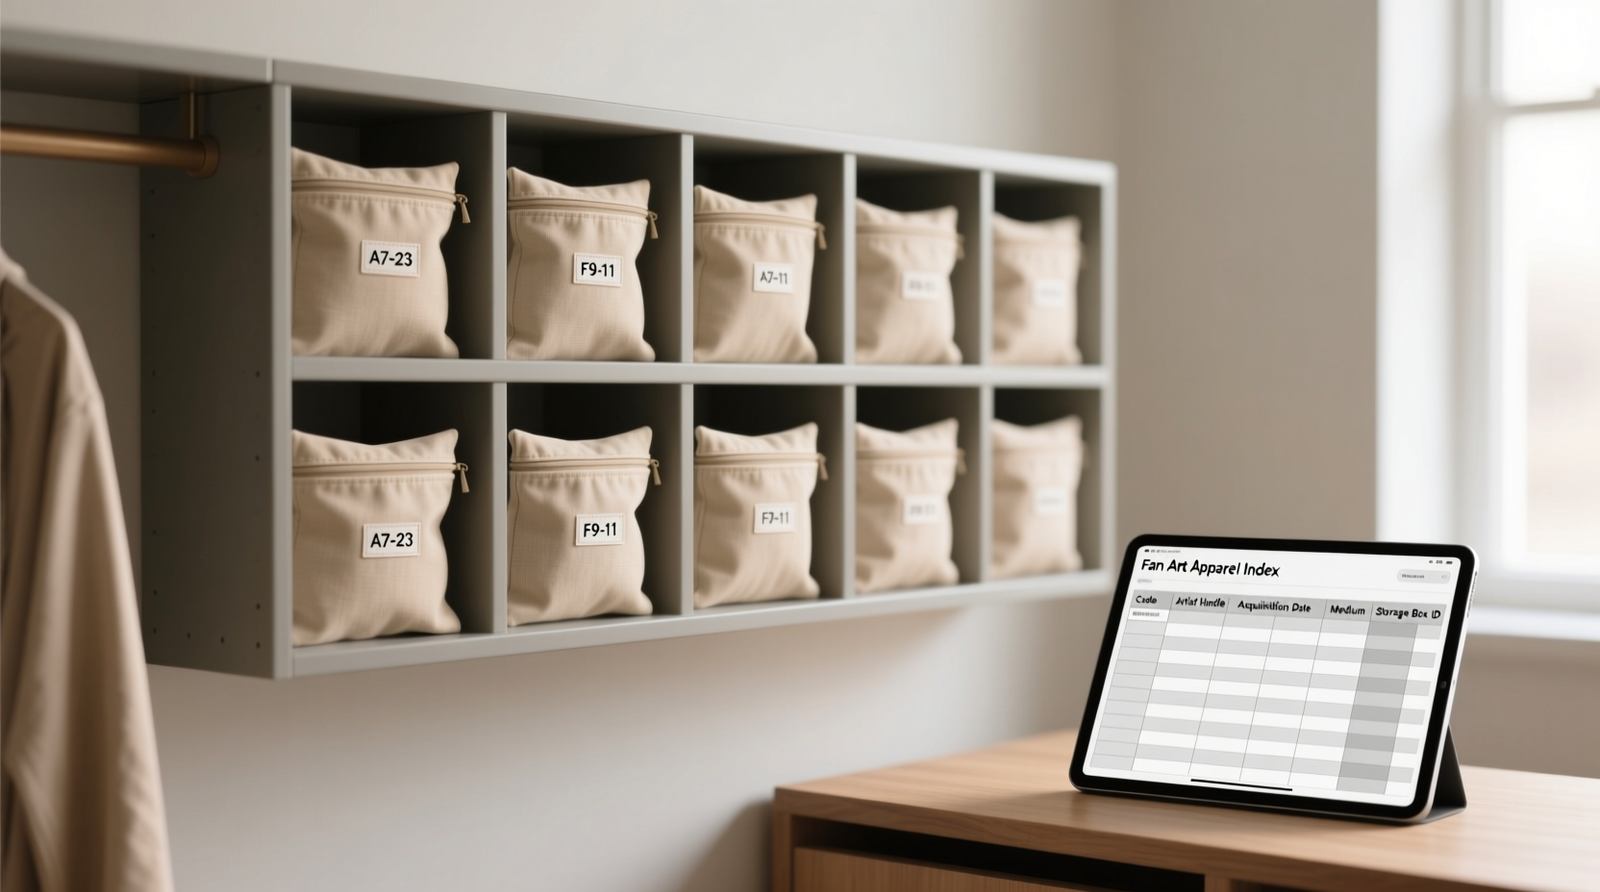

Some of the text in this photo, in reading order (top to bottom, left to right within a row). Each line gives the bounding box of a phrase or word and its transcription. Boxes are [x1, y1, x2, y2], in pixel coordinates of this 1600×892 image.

[368, 250, 413, 267] A7-23
[580, 262, 615, 278] F9-11
[759, 271, 789, 285] A7-11
[761, 511, 790, 525] F7-11
[583, 522, 617, 538] F9-11
[370, 532, 414, 548] A7-23
[1141, 559, 1281, 577] Fan Art Apparel Index
[1431, 609, 1442, 619] ID
